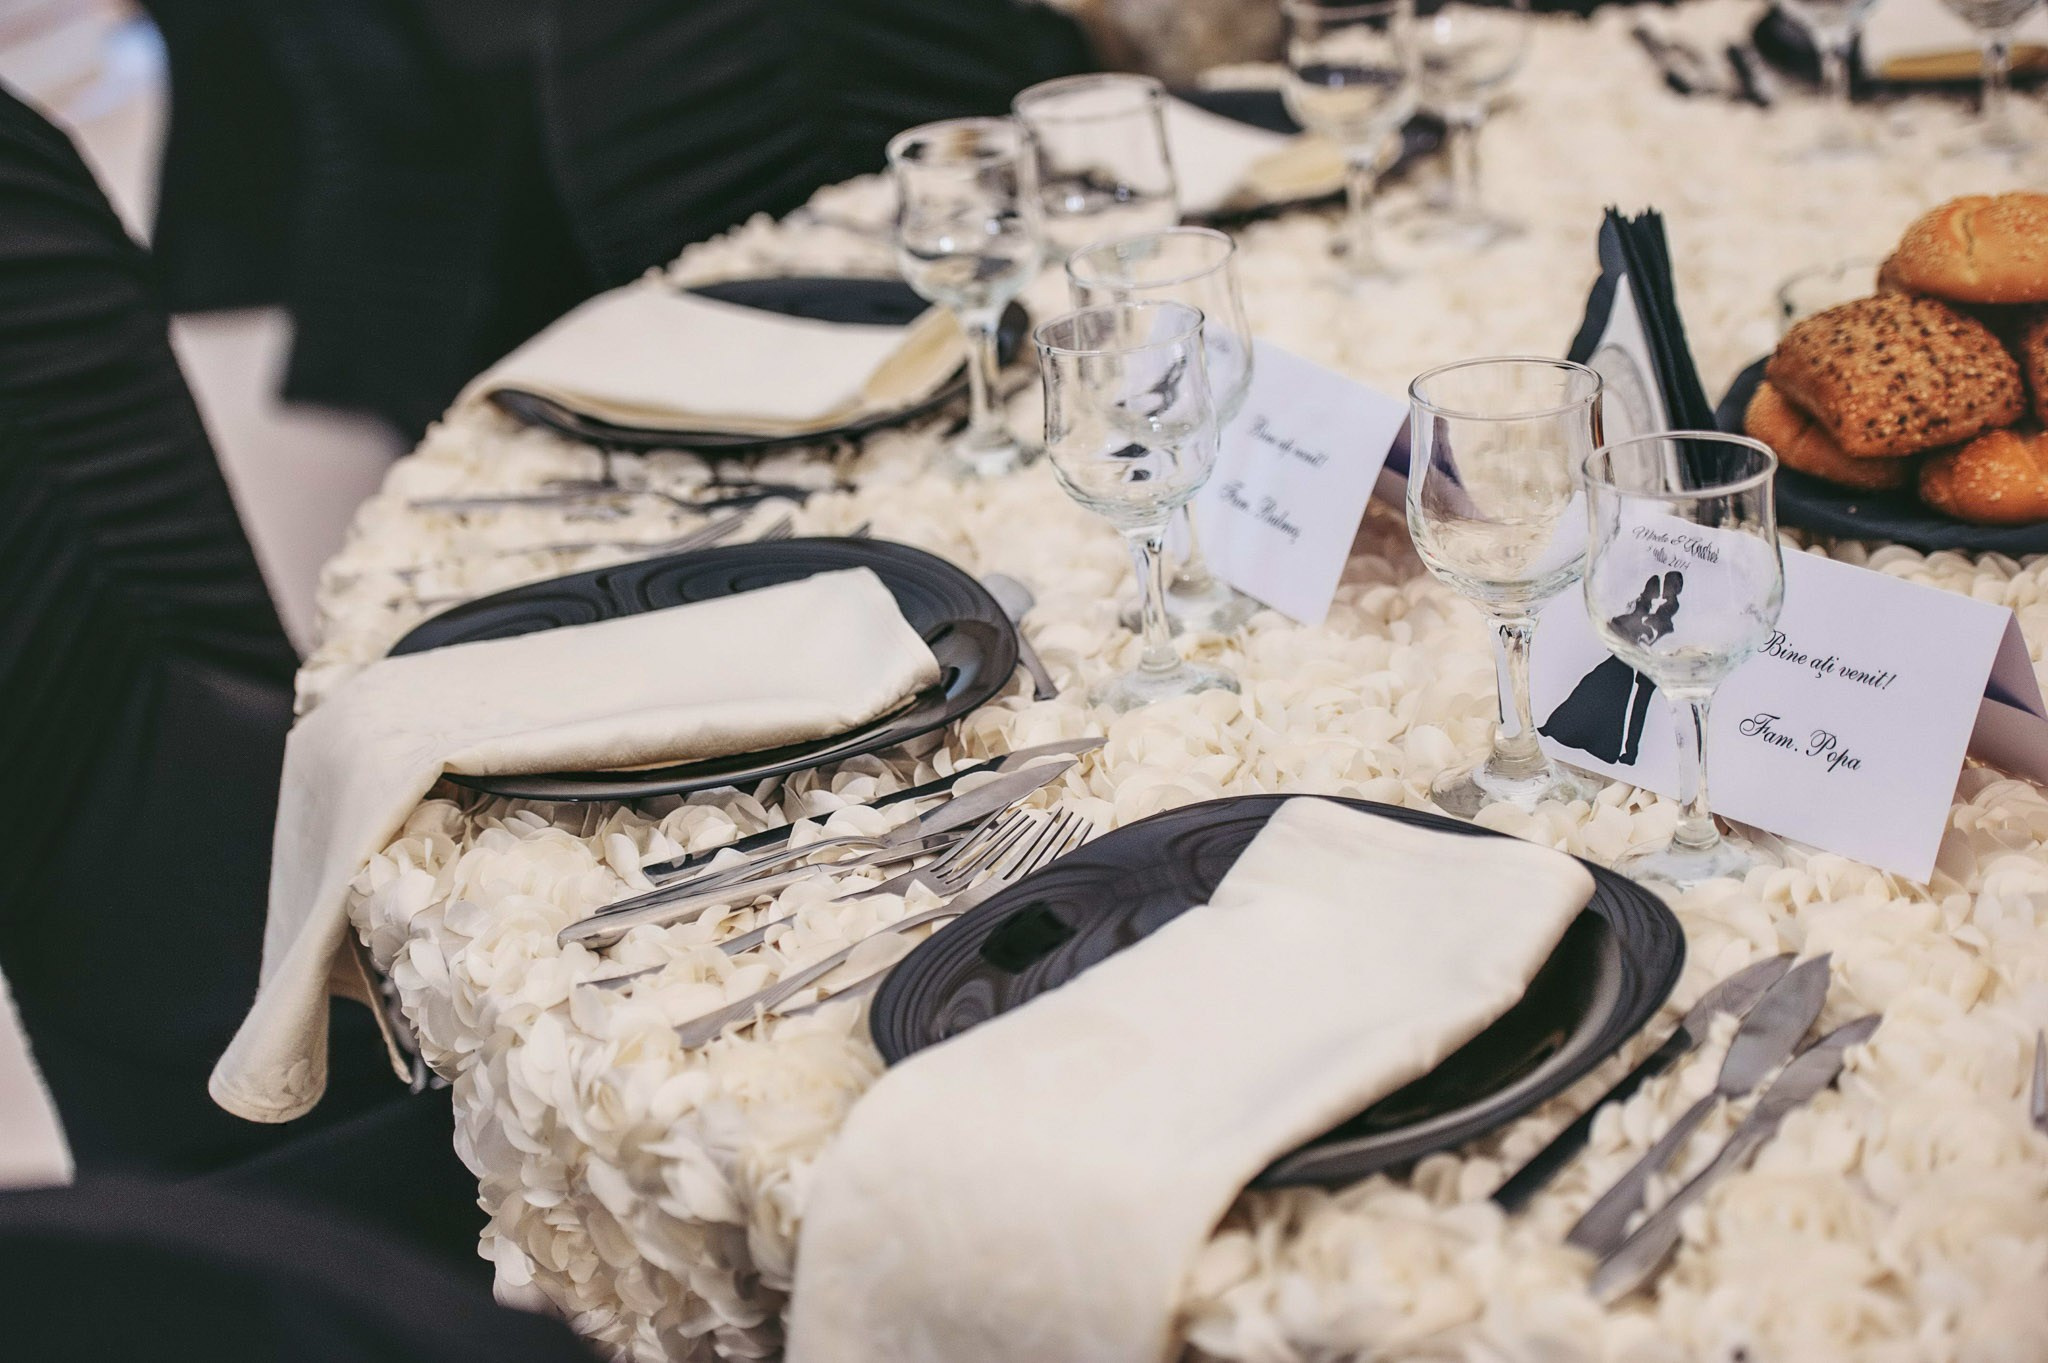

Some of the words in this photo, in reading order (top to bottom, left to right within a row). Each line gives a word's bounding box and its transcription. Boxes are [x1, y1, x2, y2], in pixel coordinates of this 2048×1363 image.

[1757, 628, 1808, 665] Bine
[1839, 665, 1898, 690] venit!
[1738, 712, 1799, 752] Fam.
[1805, 729, 1862, 773] Popa
